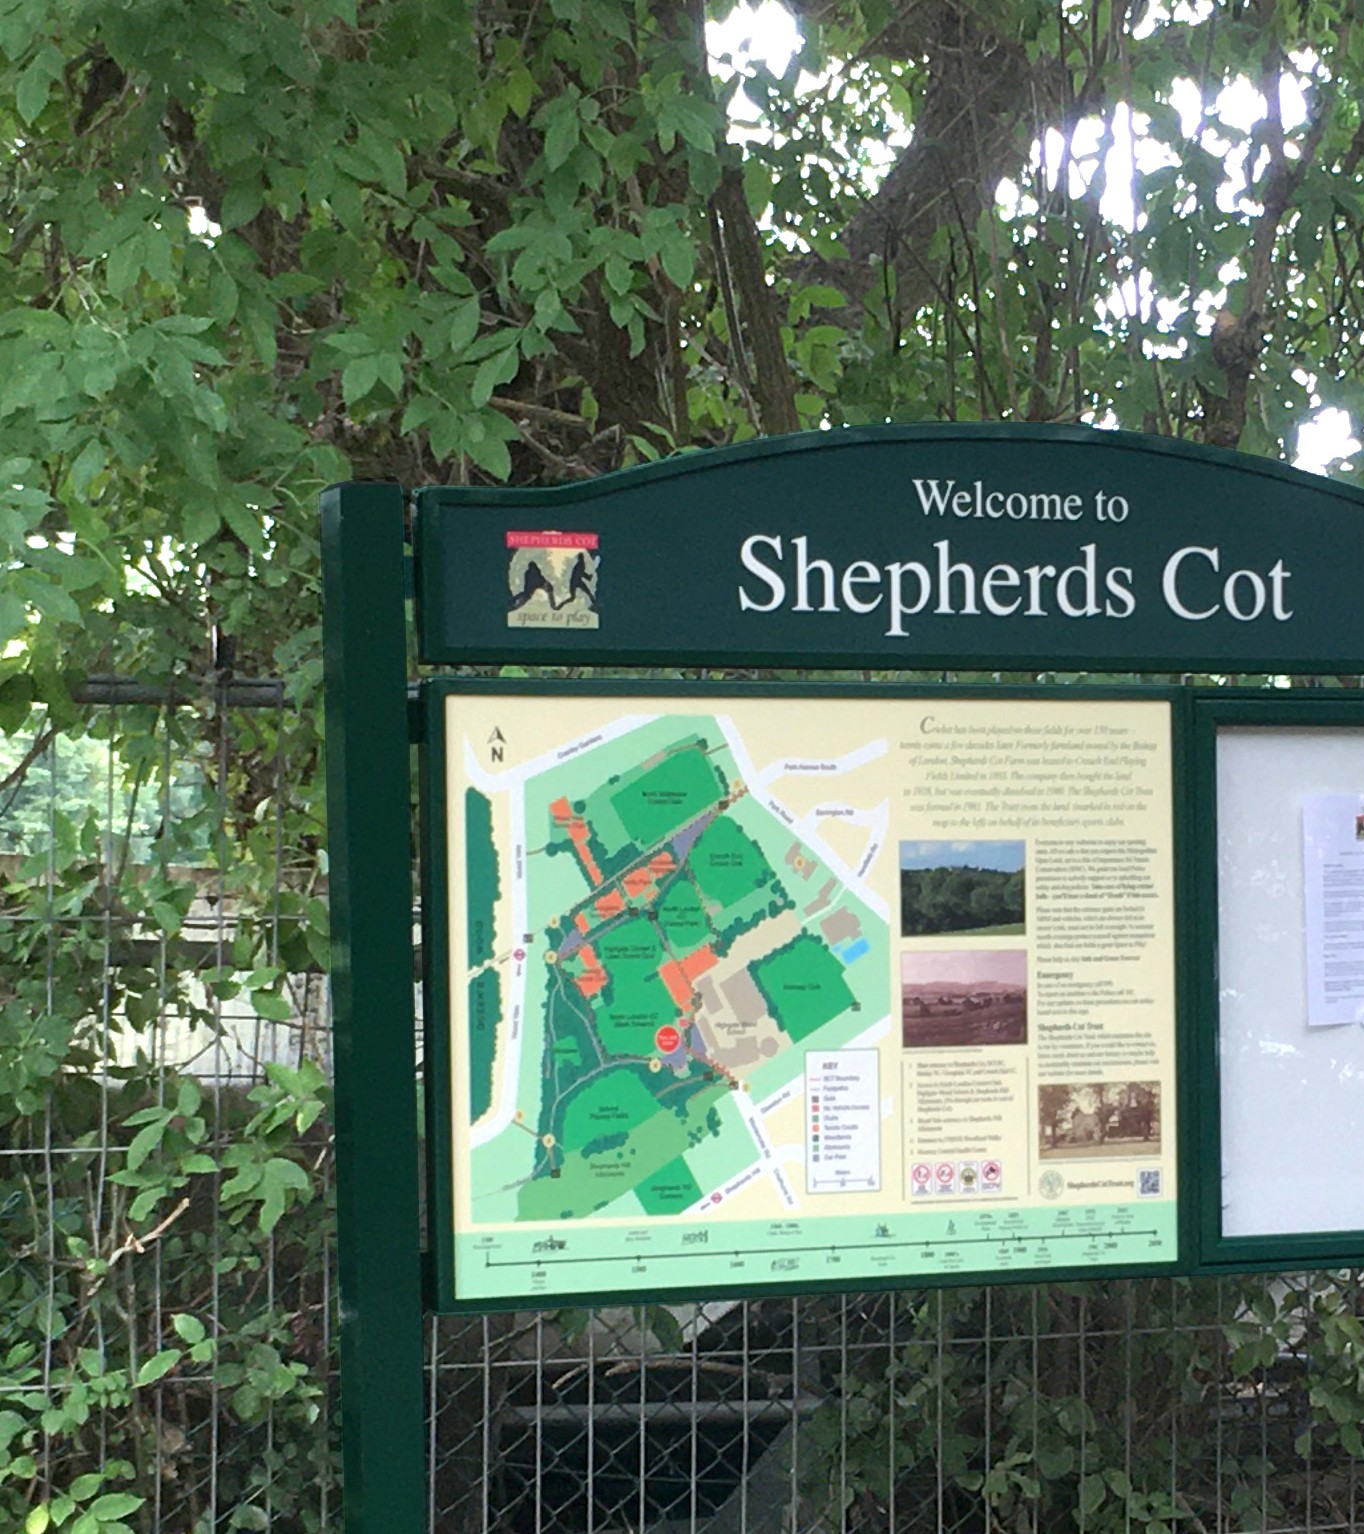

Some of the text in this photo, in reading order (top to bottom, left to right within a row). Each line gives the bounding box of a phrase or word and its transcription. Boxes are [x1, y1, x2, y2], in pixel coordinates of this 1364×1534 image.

[911, 478, 1130, 523] Welcome to
[737, 534, 1295, 638] Shepherds Cot
[491, 746, 504, 763] N
